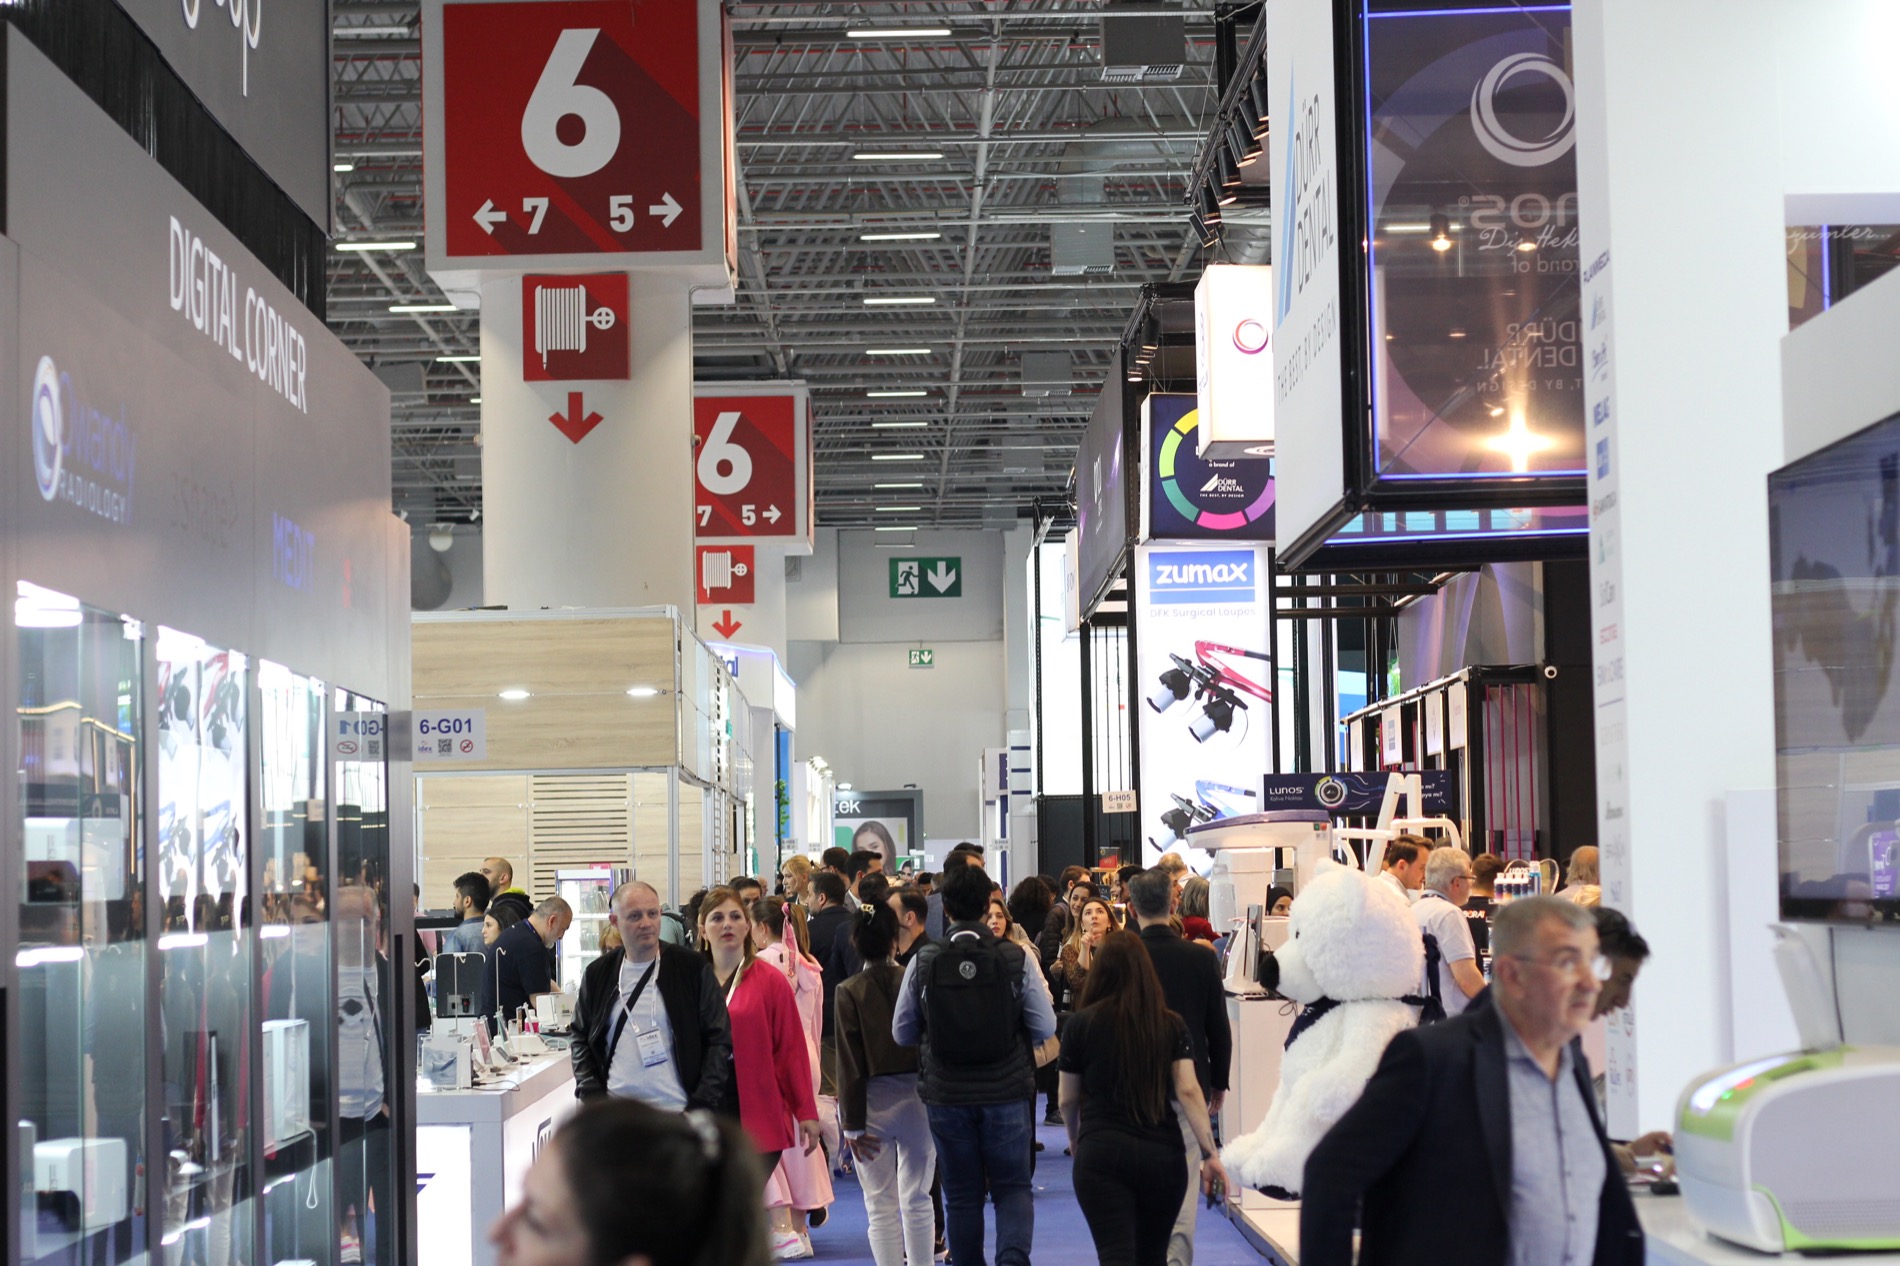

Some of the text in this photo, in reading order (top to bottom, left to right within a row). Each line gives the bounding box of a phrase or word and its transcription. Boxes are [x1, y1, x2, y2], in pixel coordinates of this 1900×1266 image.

[521, 28, 621, 178] 6
[1295, 93, 1322, 206] DÜRR
[523, 197, 549, 235] 7
[609, 195, 635, 233] 5
[1297, 168, 1334, 295] DENTAL
[170, 215, 307, 414] DIGITAL CORNER
[1313, 296, 1337, 359] DESIGN
[697, 411, 753, 495] 6
[697, 505, 712, 526] 7
[742, 504, 756, 526] 5
[1156, 562, 1248, 585] zumax
[1150, 606, 1256, 620] DFK Surgical Loupes
[419, 718, 472, 735] 6-G01
[1108, 794, 1131, 802] 6-H05
